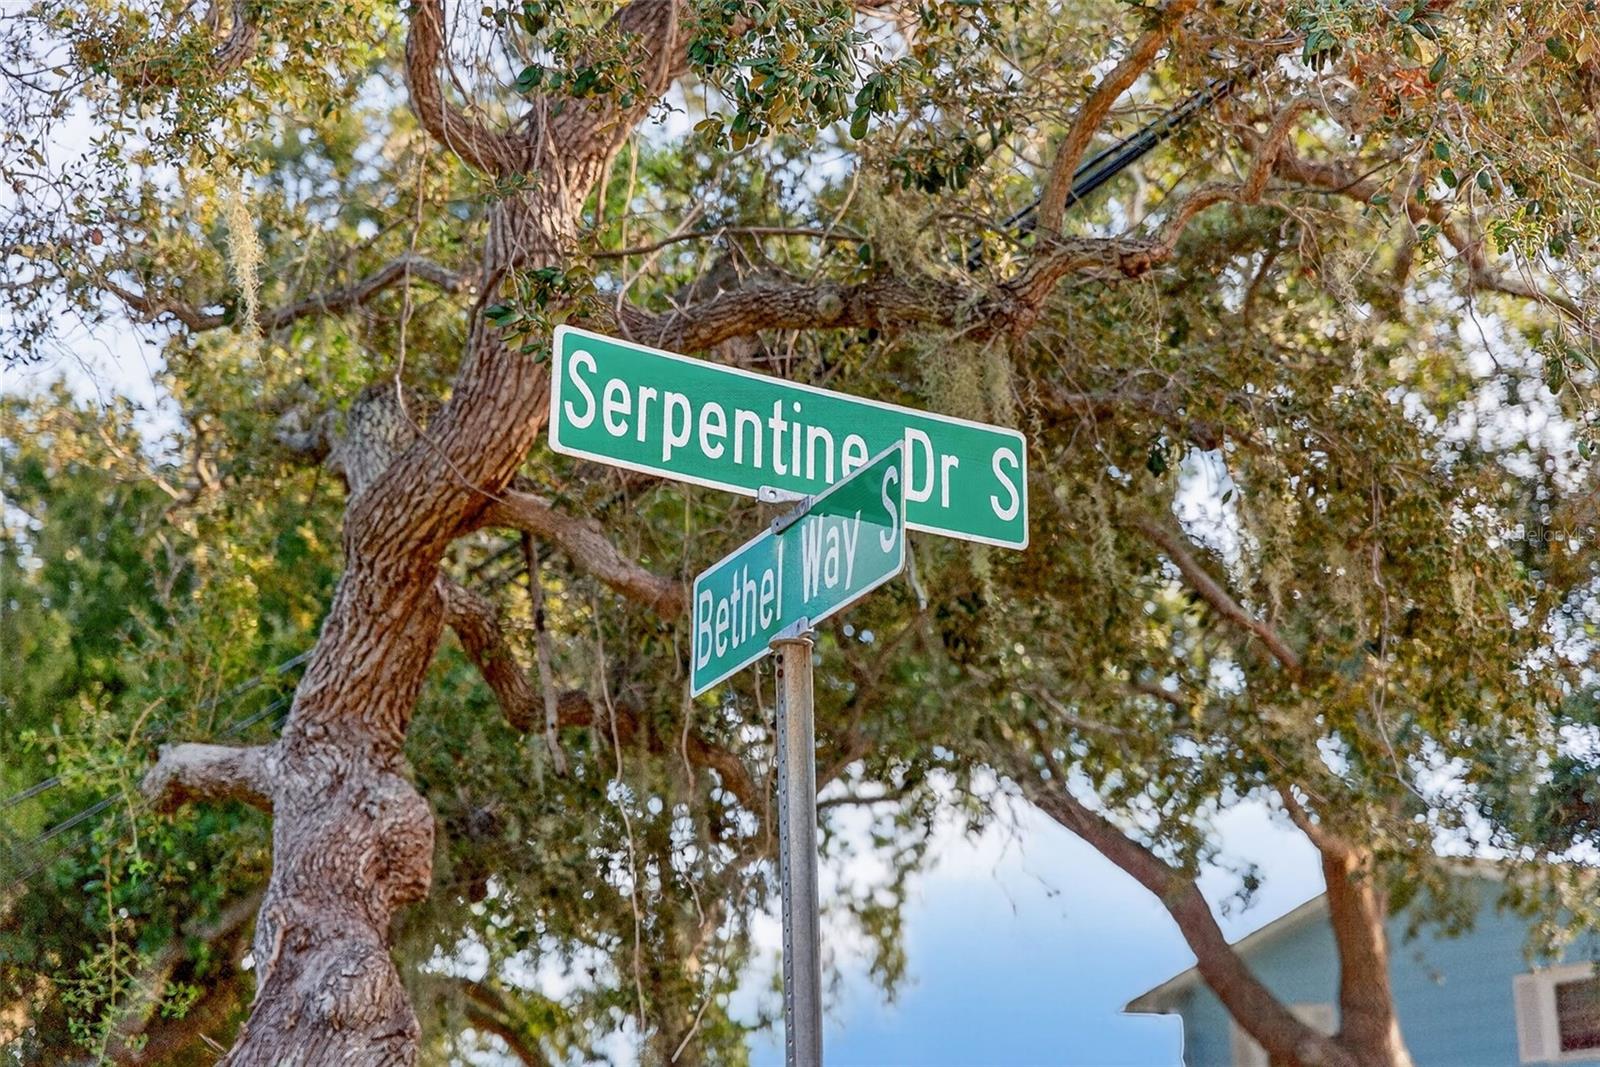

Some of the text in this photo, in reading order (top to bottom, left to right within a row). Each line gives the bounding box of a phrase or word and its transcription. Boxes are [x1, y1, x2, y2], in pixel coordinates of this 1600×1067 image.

[564, 349, 1020, 521] Serpentine Dr S
[696, 465, 899, 672] Bethel Way S
